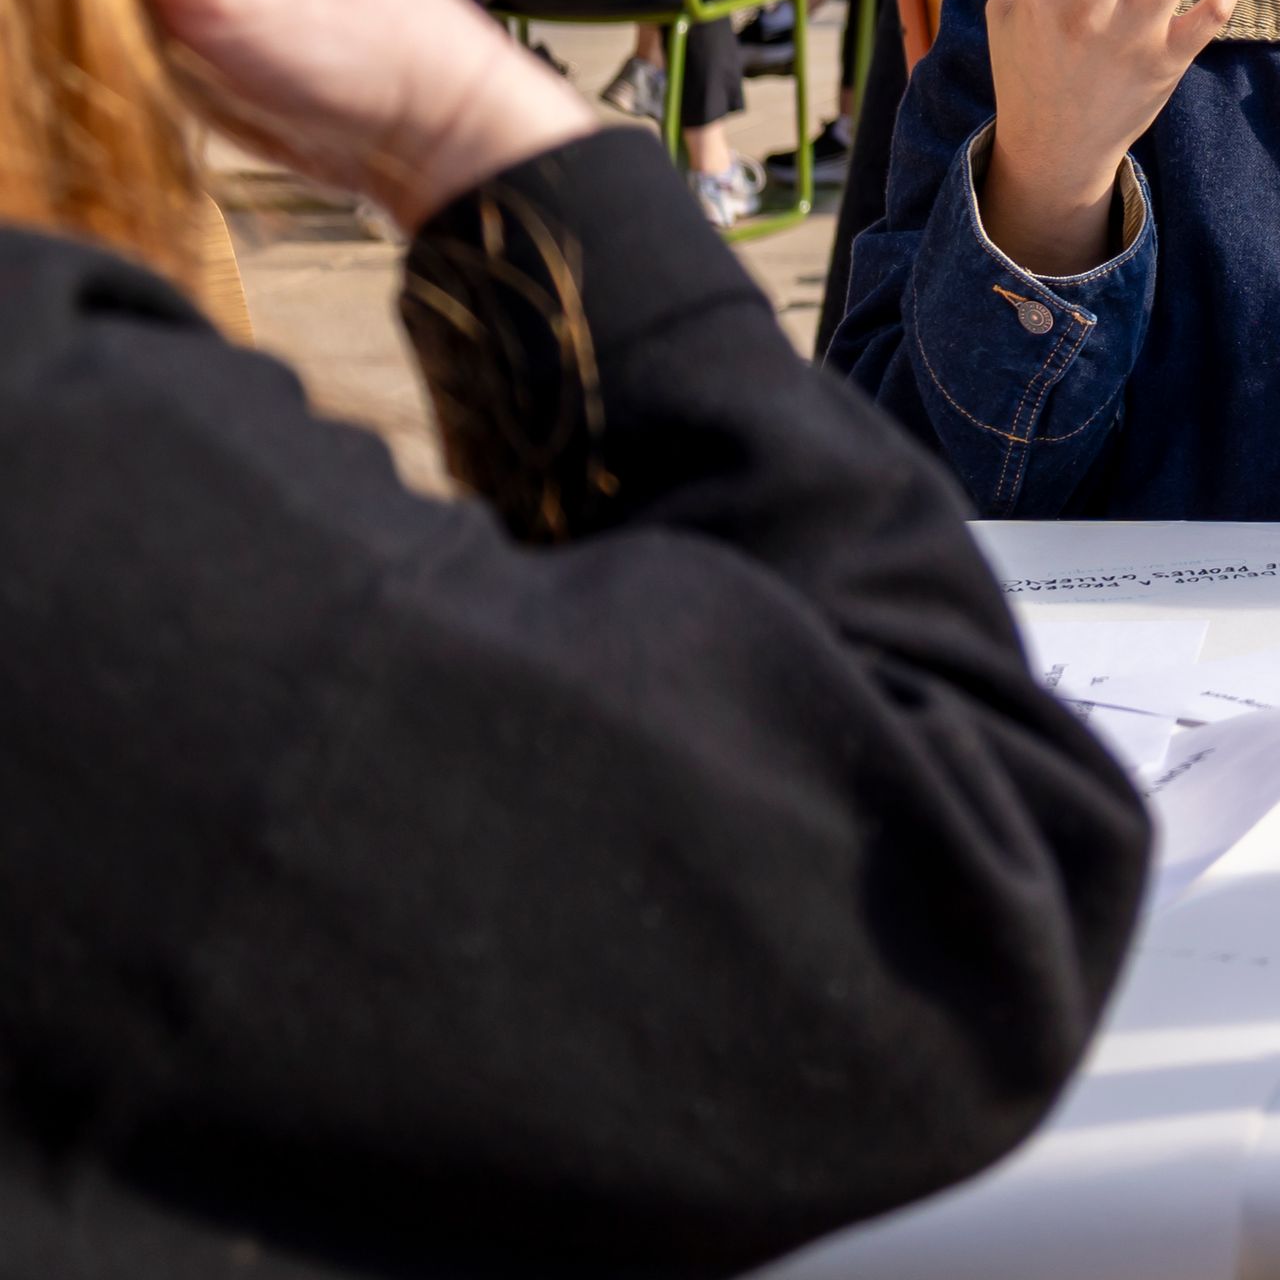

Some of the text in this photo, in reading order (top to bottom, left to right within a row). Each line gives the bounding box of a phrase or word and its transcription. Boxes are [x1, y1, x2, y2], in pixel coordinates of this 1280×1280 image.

[1152, 565, 1248, 578] PEOPLE'S
[1174, 570, 1276, 583] DEVELOP
[1025, 574, 1136, 585] GALLERY
